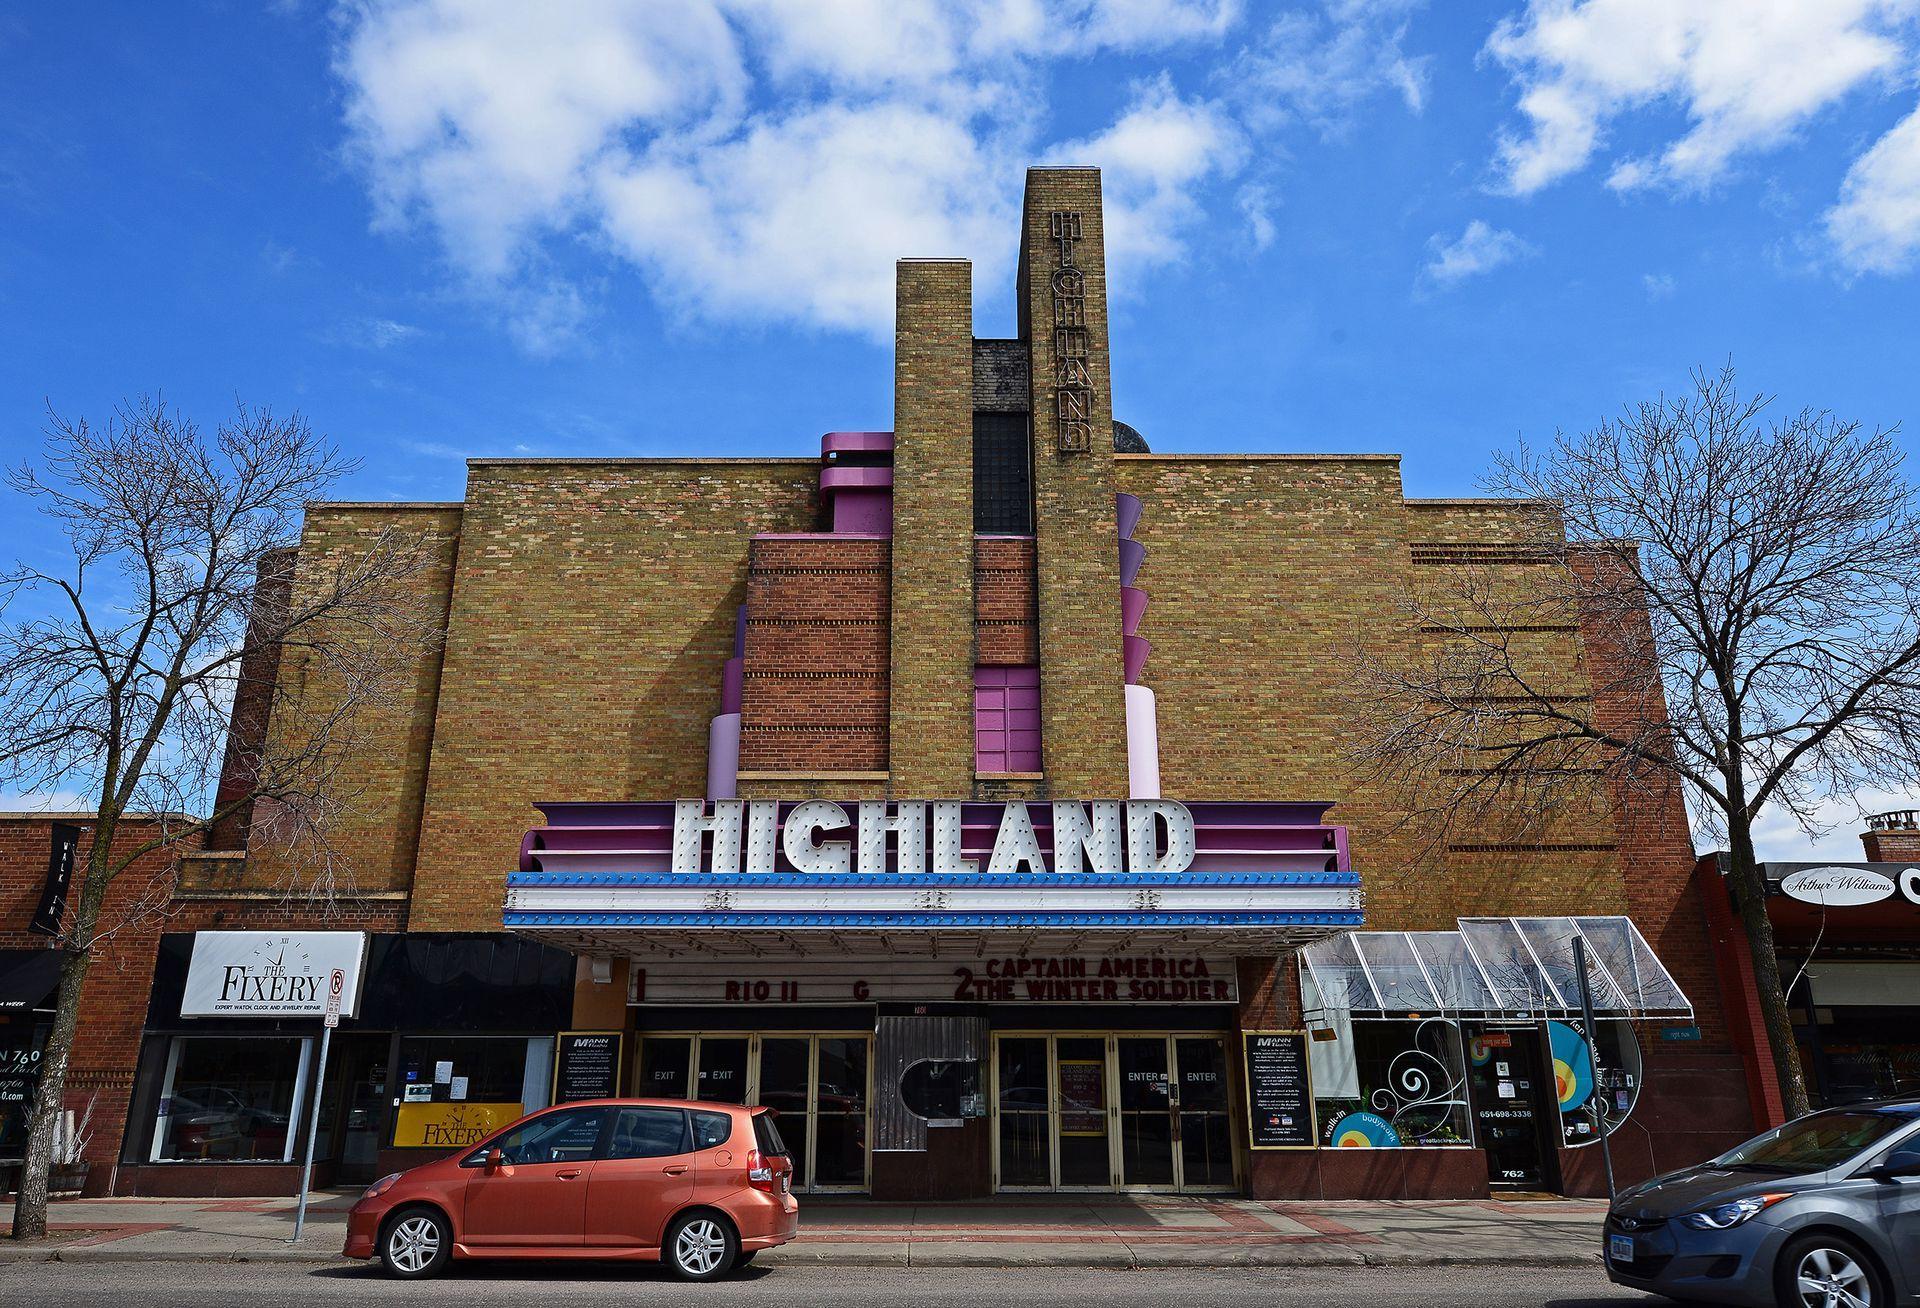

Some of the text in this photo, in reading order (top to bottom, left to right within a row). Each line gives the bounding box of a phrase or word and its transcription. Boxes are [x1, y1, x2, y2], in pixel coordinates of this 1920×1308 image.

[1051, 211, 1094, 453] HIGHLAND
[671, 799, 1196, 874] HIGHLAND
[58, 841, 69, 883] WALK
[1786, 876, 1833, 893] Arthur
[1830, 875, 1892, 891] Williams
[263, 965, 286, 976] THE
[986, 958, 1210, 979] CAPTAIN AMERICA
[216, 965, 325, 1001] FIXERY
[725, 980, 770, 1001] RIO
[853, 980, 869, 1001] G
[953, 967, 1229, 1000] 2 THE WINTER SOLDIER
[1569, 1020, 1585, 1035] day
[1257, 1038, 1292, 1047] MANN
[12, 1050, 40, 1064] 760
[654, 1071, 675, 1080] EXIT
[712, 1070, 733, 1080] EXIT
[1128, 1072, 1158, 1081] ENTER
[1187, 1072, 1217, 1081] ENTER
[1479, 1110, 1532, 1118] 651-698-3338
[1324, 1109, 1347, 1138] walk-in
[1361, 1114, 1396, 1143] bodywork
[421, 1123, 492, 1145] FIXERY
[1501, 1170, 1525, 1178] 762
